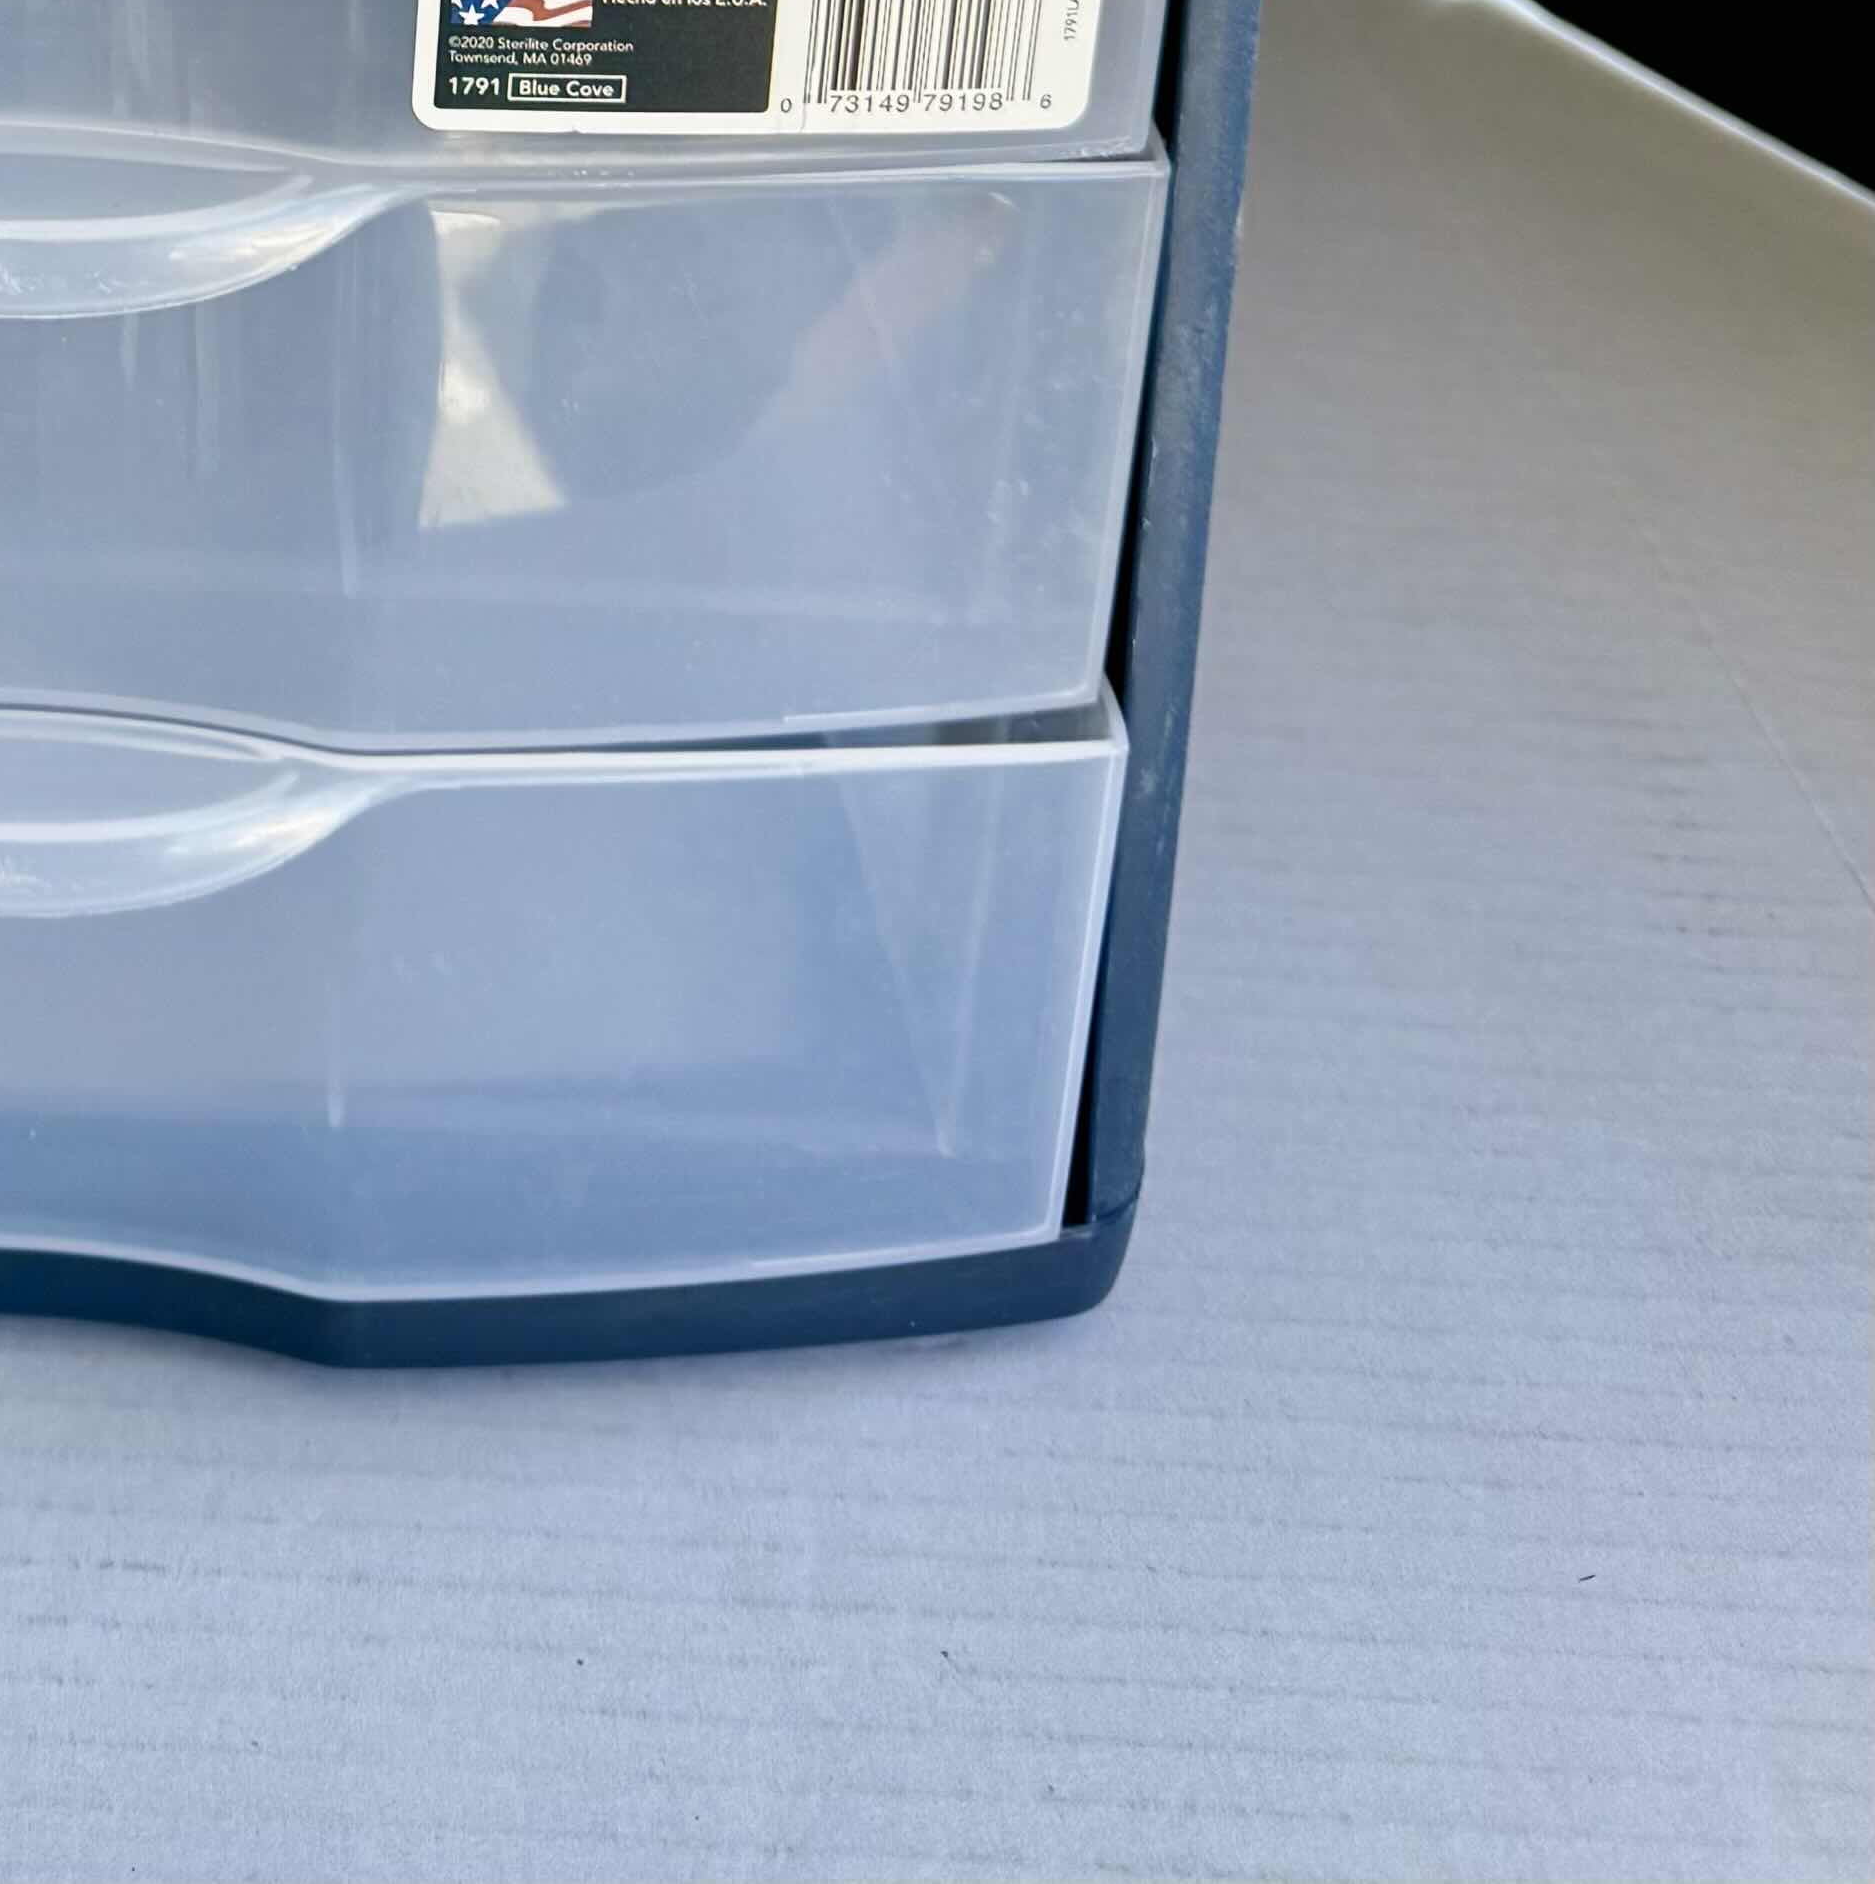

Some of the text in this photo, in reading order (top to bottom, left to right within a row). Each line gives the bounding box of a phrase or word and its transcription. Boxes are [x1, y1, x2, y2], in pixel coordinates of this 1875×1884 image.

[498, 37, 548, 50] Sterilite
[552, 39, 633, 53] Corporation
[449, 51, 592, 66] Townsend, MA 01469
[449, 76, 614, 97] 1791 Blue Cove
[780, 93, 1052, 113] 0 73149 79198 6
